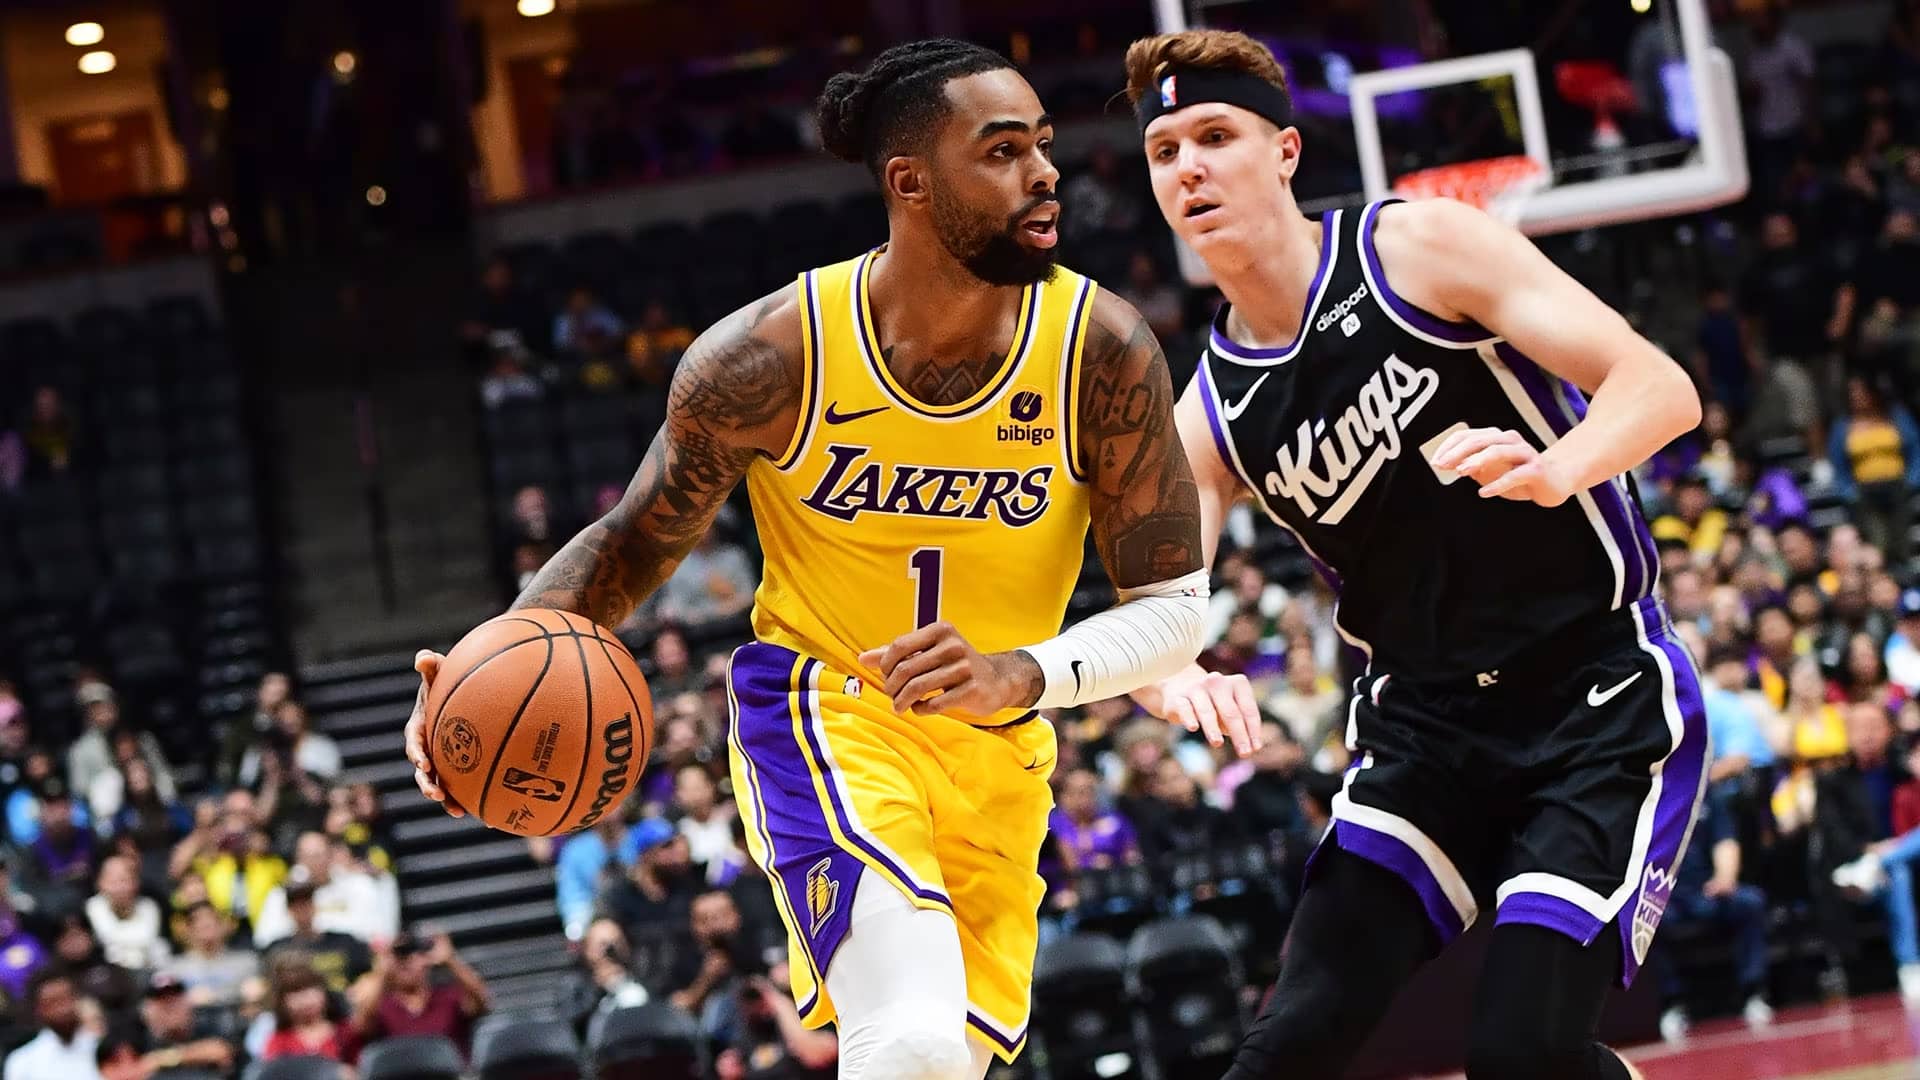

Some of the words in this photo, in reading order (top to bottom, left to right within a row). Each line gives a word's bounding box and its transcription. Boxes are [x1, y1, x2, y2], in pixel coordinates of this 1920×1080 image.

[1316, 282, 1368, 331] dialpad
[997, 425, 1055, 446] bibigo
[1265, 353, 1440, 525] Kings
[799, 443, 1056, 528] LAKERS
[908, 545, 944, 632] 1
